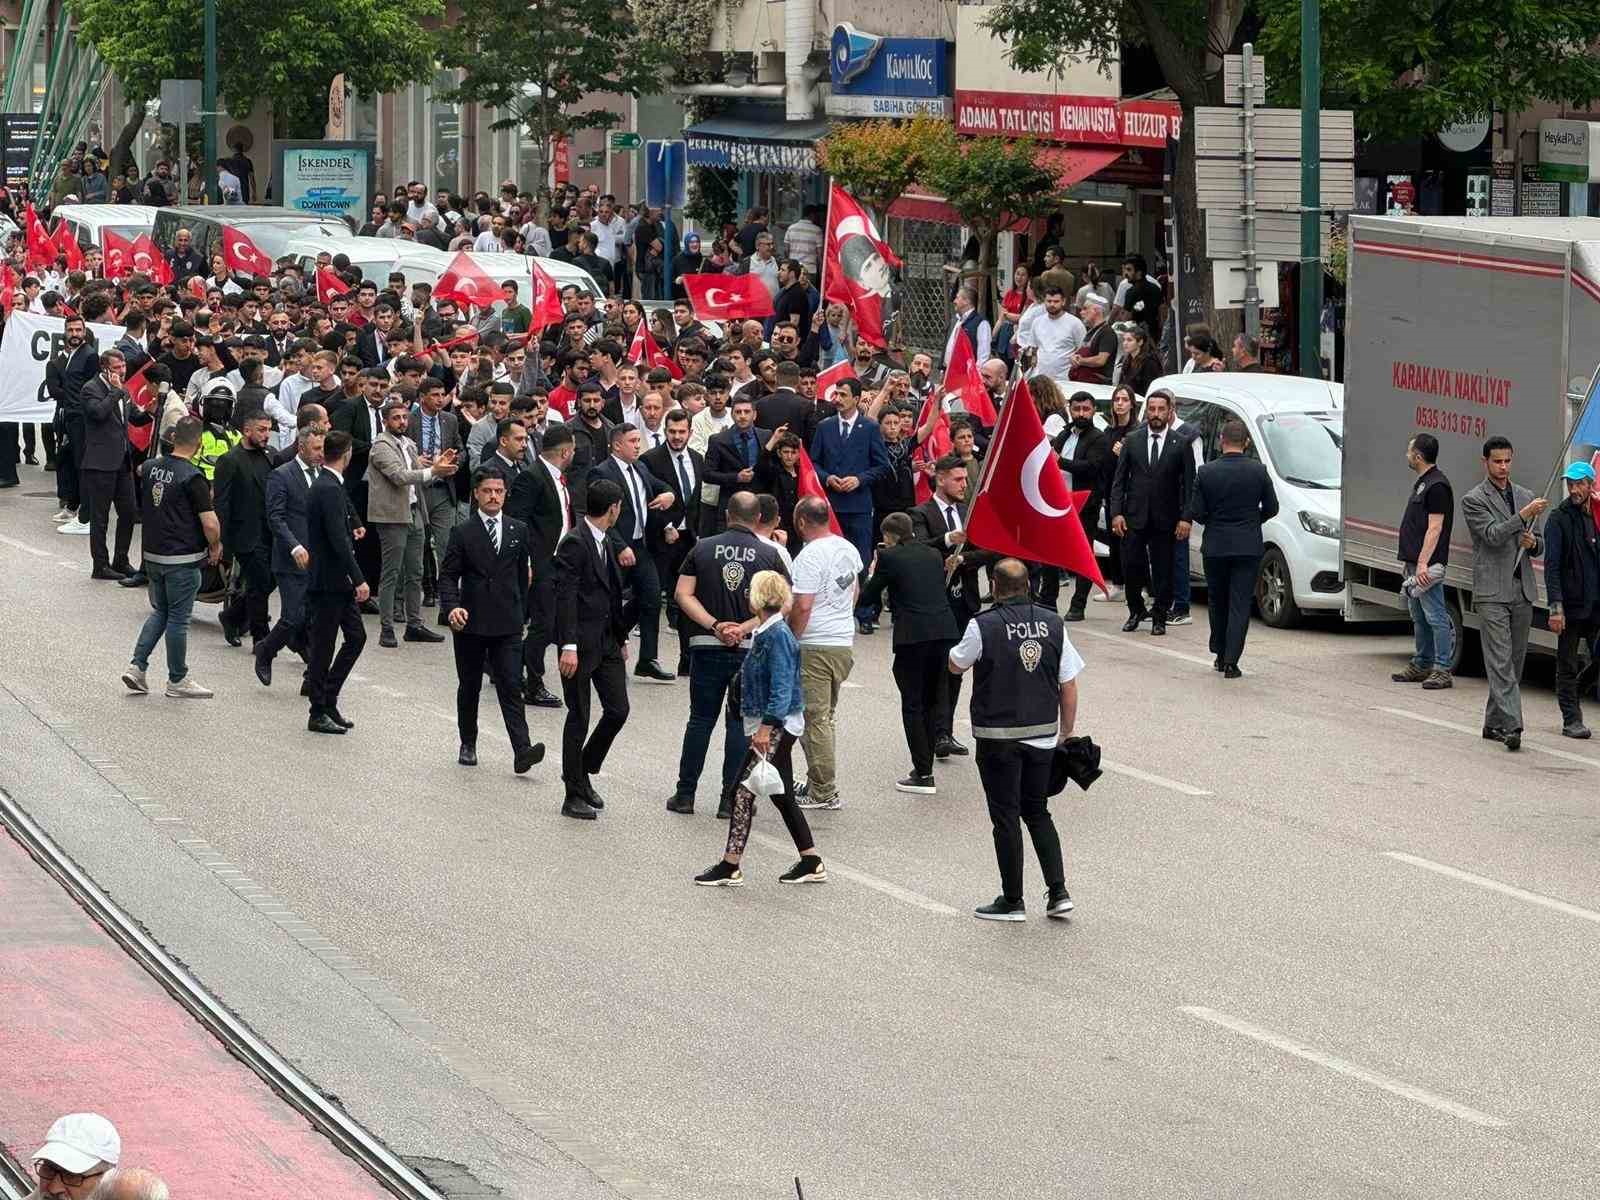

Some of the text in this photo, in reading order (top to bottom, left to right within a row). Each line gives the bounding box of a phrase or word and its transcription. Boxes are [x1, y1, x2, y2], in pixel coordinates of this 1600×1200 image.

[959, 106, 997, 129] ADANA
[1059, 105, 1090, 131] KENAN
[1090, 106, 1116, 133] USTA
[1124, 111, 1168, 139] HUZUR
[301, 200, 351, 209] DOWNTOWN
[1392, 360, 1512, 407] KARAKAYA NAKLİYAT
[1416, 406, 1487, 439] 0535 313 67 51
[714, 544, 756, 562] POLIS
[1006, 621, 1049, 640] POLIS
